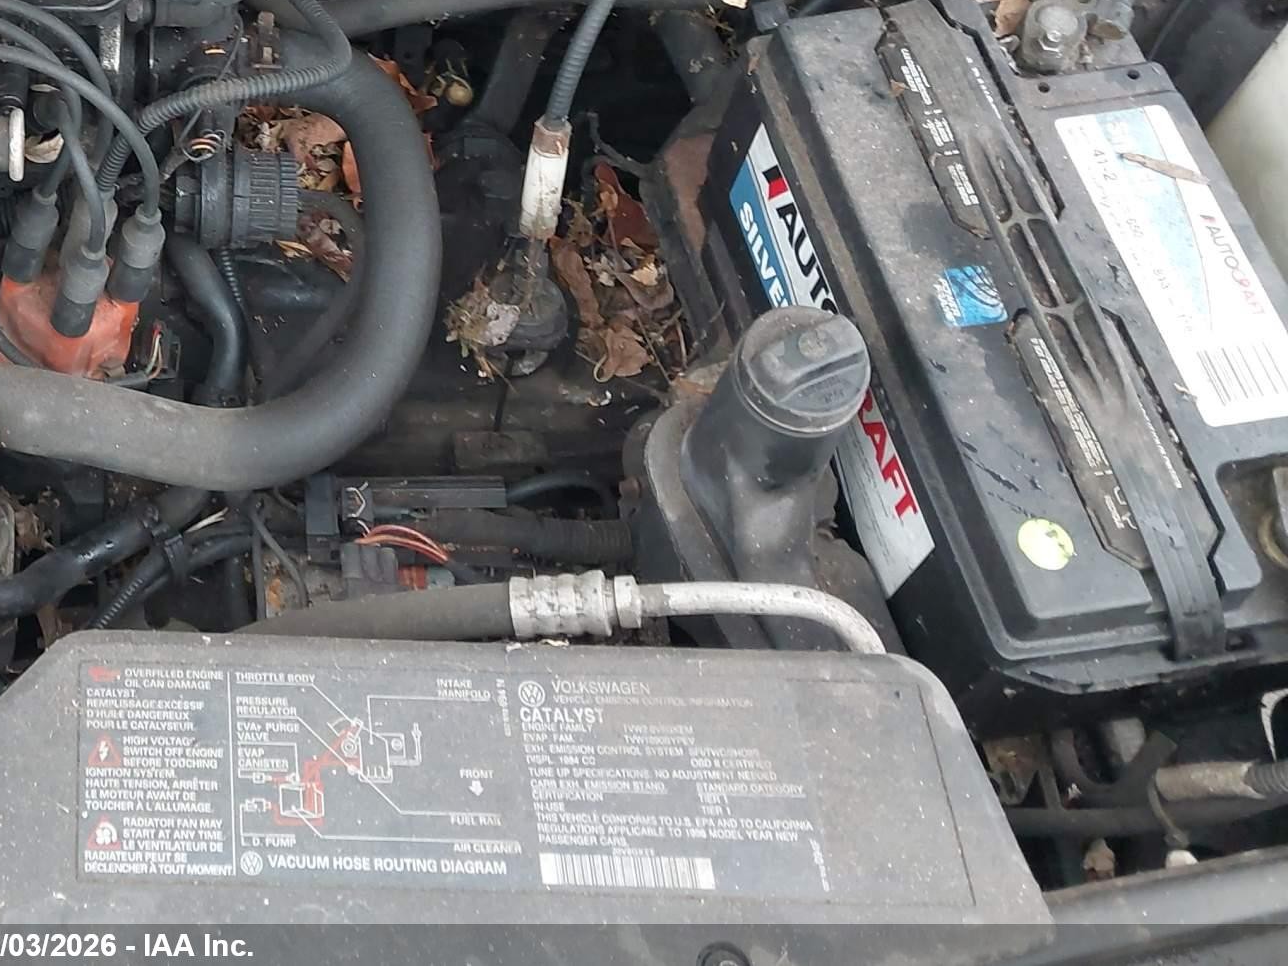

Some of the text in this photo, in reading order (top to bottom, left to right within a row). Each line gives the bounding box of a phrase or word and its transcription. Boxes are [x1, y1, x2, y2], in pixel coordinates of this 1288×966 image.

[739, 201, 789, 308] SILVE
[124, 668, 224, 681] OVERFILLED ENGINE
[235, 672, 316, 684] THROTTLE BODY
[124, 679, 211, 690] OIL CAN DAMAGE
[436, 678, 473, 689] INTAKE
[551, 680, 651, 695] VOLKSWAGEN
[437, 688, 491, 700] MANIFOLD
[86, 698, 204, 711] REMPLISSAGE EXCESSIF
[236, 696, 288, 706] PRESSURE
[127, 709, 190, 721] DANGEREUX
[236, 705, 297, 716] REGULATOR
[519, 706, 605, 724] CATALYST
[86, 719, 114, 730] POUR
[116, 720, 128, 730] LE
[265, 722, 300, 733] PURGE
[521, 721, 593, 733] ENGINE FAMILY
[123, 736, 196, 747] HIGH VOLTAG
[237, 731, 269, 742] VALVE
[123, 746, 224, 759] SWITCH OFF ENGINE
[238, 747, 265, 758] EVAP
[549, 744, 595, 755] EMISSION
[596, 745, 643, 756] CONTROL
[645, 746, 684, 757] SYSTEM
[123, 757, 218, 769] BEFORE TOUCHING
[238, 758, 289, 770] CANISTER
[581, 755, 596, 766] CC
[85, 767, 130, 778] IGNITION
[459, 769, 494, 779] FRONT
[528, 767, 554, 778] TUNE
[556, 767, 571, 778] UP
[654, 769, 670, 780] NO
[671, 769, 734, 781] ADJUSTMENT
[85, 778, 121, 788] HAUTE
[172, 777, 218, 791] ARRÊTER
[583, 780, 631, 792] EMISSION
[695, 782, 804, 795] STANDARD CATEGORY
[85, 790, 196, 802] LE MOTEUR AVANT DE
[531, 791, 604, 802] CERTIFICATION
[698, 793, 721, 804] TIER
[85, 800, 134, 811] TOUCHER
[136, 798, 145, 811] À
[701, 805, 723, 816] TIER
[123, 817, 223, 829] RADIATOR FAN MAY
[450, 814, 477, 826] FUEL
[535, 812, 558, 823] THIS
[559, 812, 599, 824] VEHICLE
[601, 813, 658, 826] CONFORMS
[658, 815, 673, 827] TO
[695, 816, 716, 827] EPA
[717, 817, 738, 829] AND
[740, 817, 753, 829] TO
[755, 818, 814, 832] CALIFORNIA
[122, 829, 155, 839] START
[157, 829, 171, 839] AT
[173, 829, 195, 840] ANY
[536, 822, 606, 835] REGULATIONS
[607, 824, 666, 837] APPLICABLE
[668, 828, 682, 838] TO
[708, 828, 744, 841] MODEL
[746, 829, 774, 842] YEAR
[775, 831, 799, 843] NEW
[265, 837, 297, 849] PUMP
[538, 833, 599, 846] PASSENGER
[123, 840, 224, 853] LE VENTILATEUR DE
[453, 841, 522, 854] AIR CLEANER
[84, 850, 187, 863] RADIATEUR PEUT SE
[84, 861, 148, 874] DÉCLENCHER
[149, 861, 158, 874] À
[159, 864, 185, 875] TOUT
[267, 853, 508, 875] VACUUM HOSE ROUTING DIAGRAM
